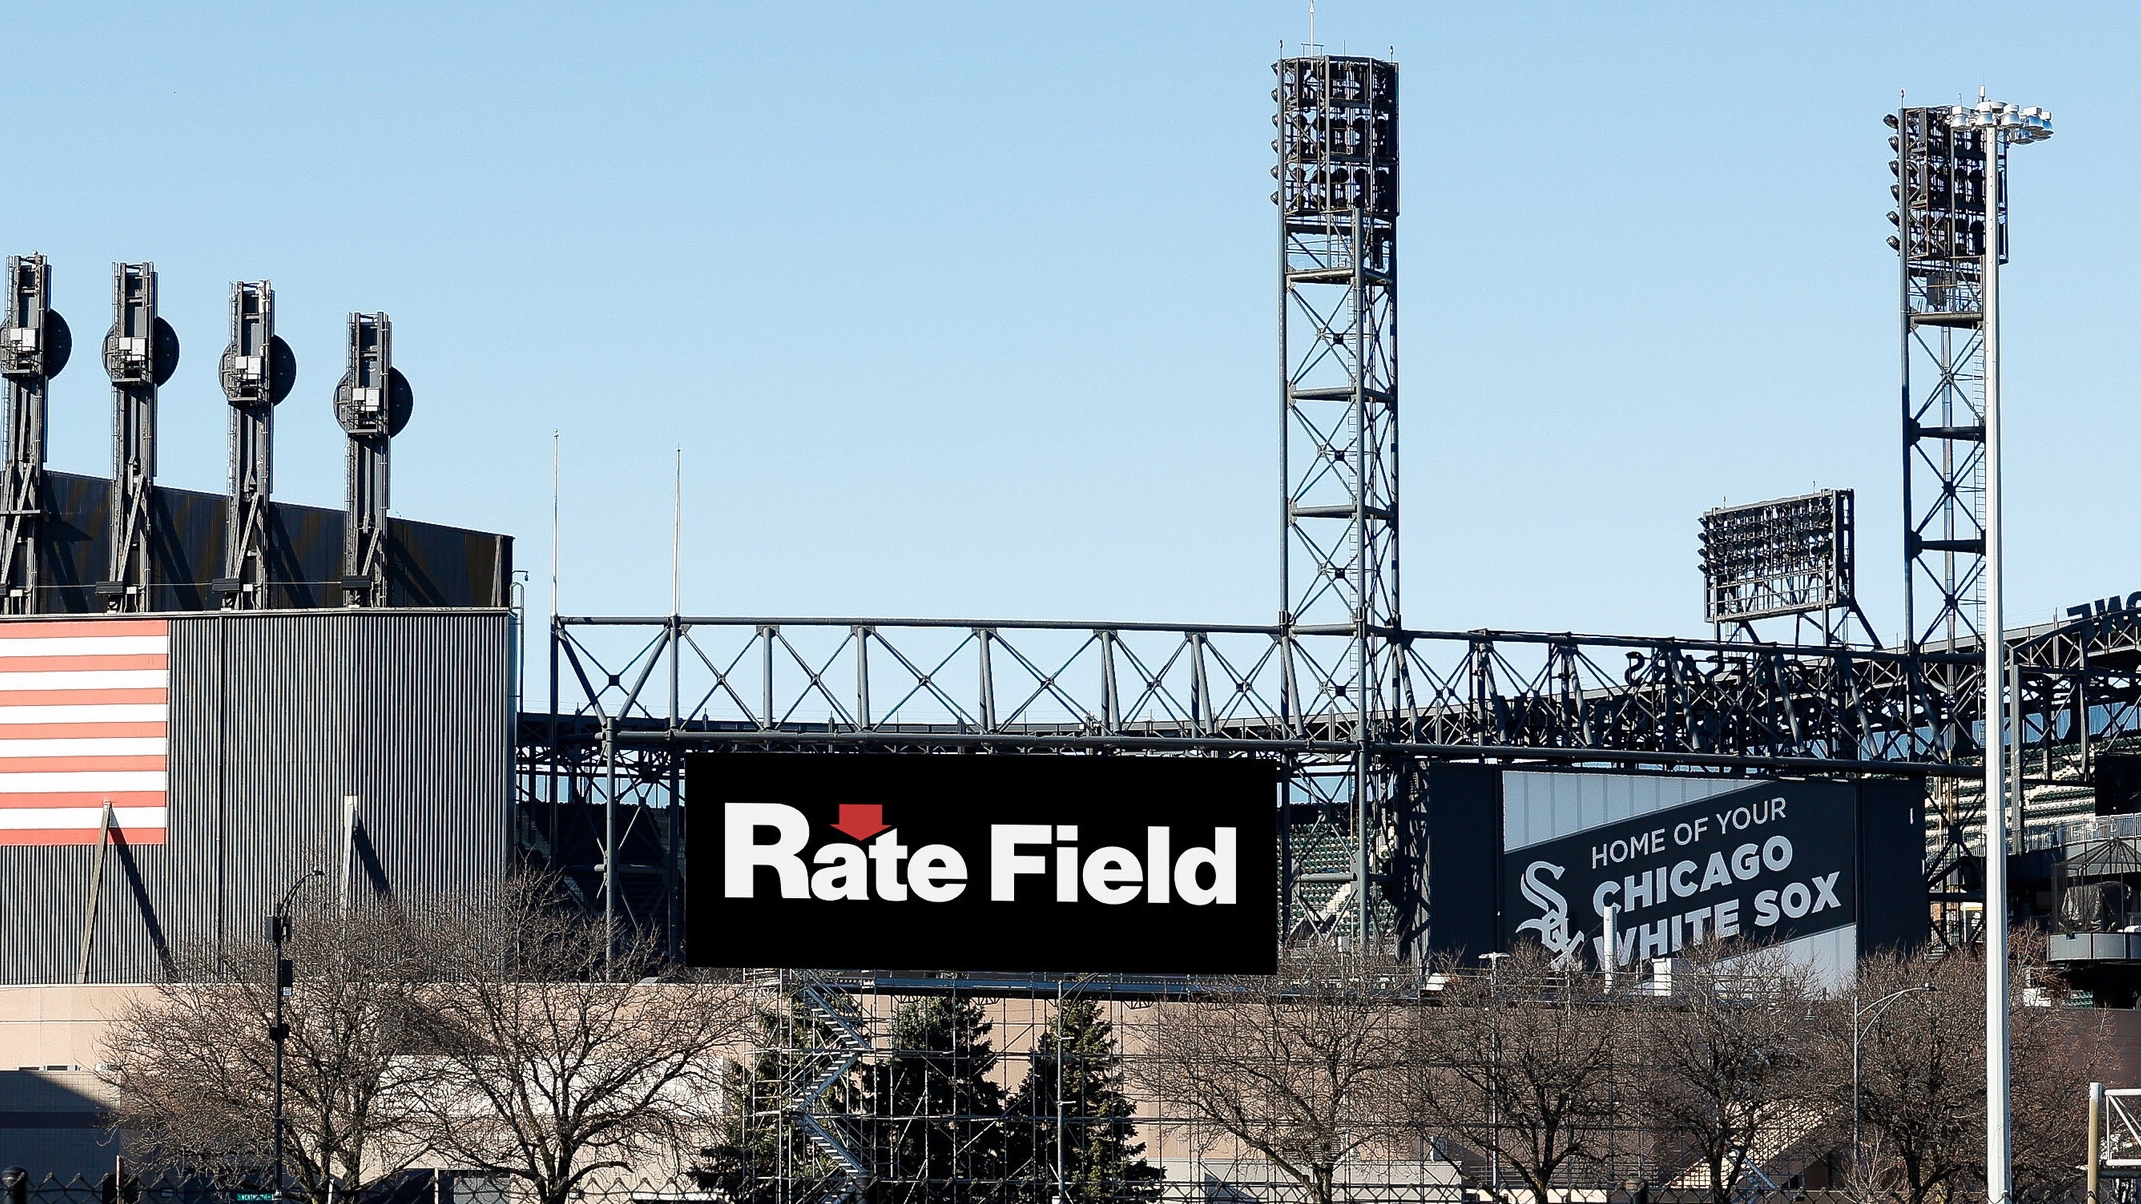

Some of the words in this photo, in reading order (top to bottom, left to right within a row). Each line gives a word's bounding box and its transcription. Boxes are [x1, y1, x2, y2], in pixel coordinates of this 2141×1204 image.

[724, 802, 968, 903] Rate
[990, 824, 1238, 906] Field
[1592, 828, 1666, 869] HOME
[1674, 817, 1709, 846] OF
[1715, 797, 1787, 836] YOUR
[1592, 835, 1793, 918] CHICAGO
[1592, 898, 1740, 972] WHITE
[1754, 871, 1842, 927] SOX
